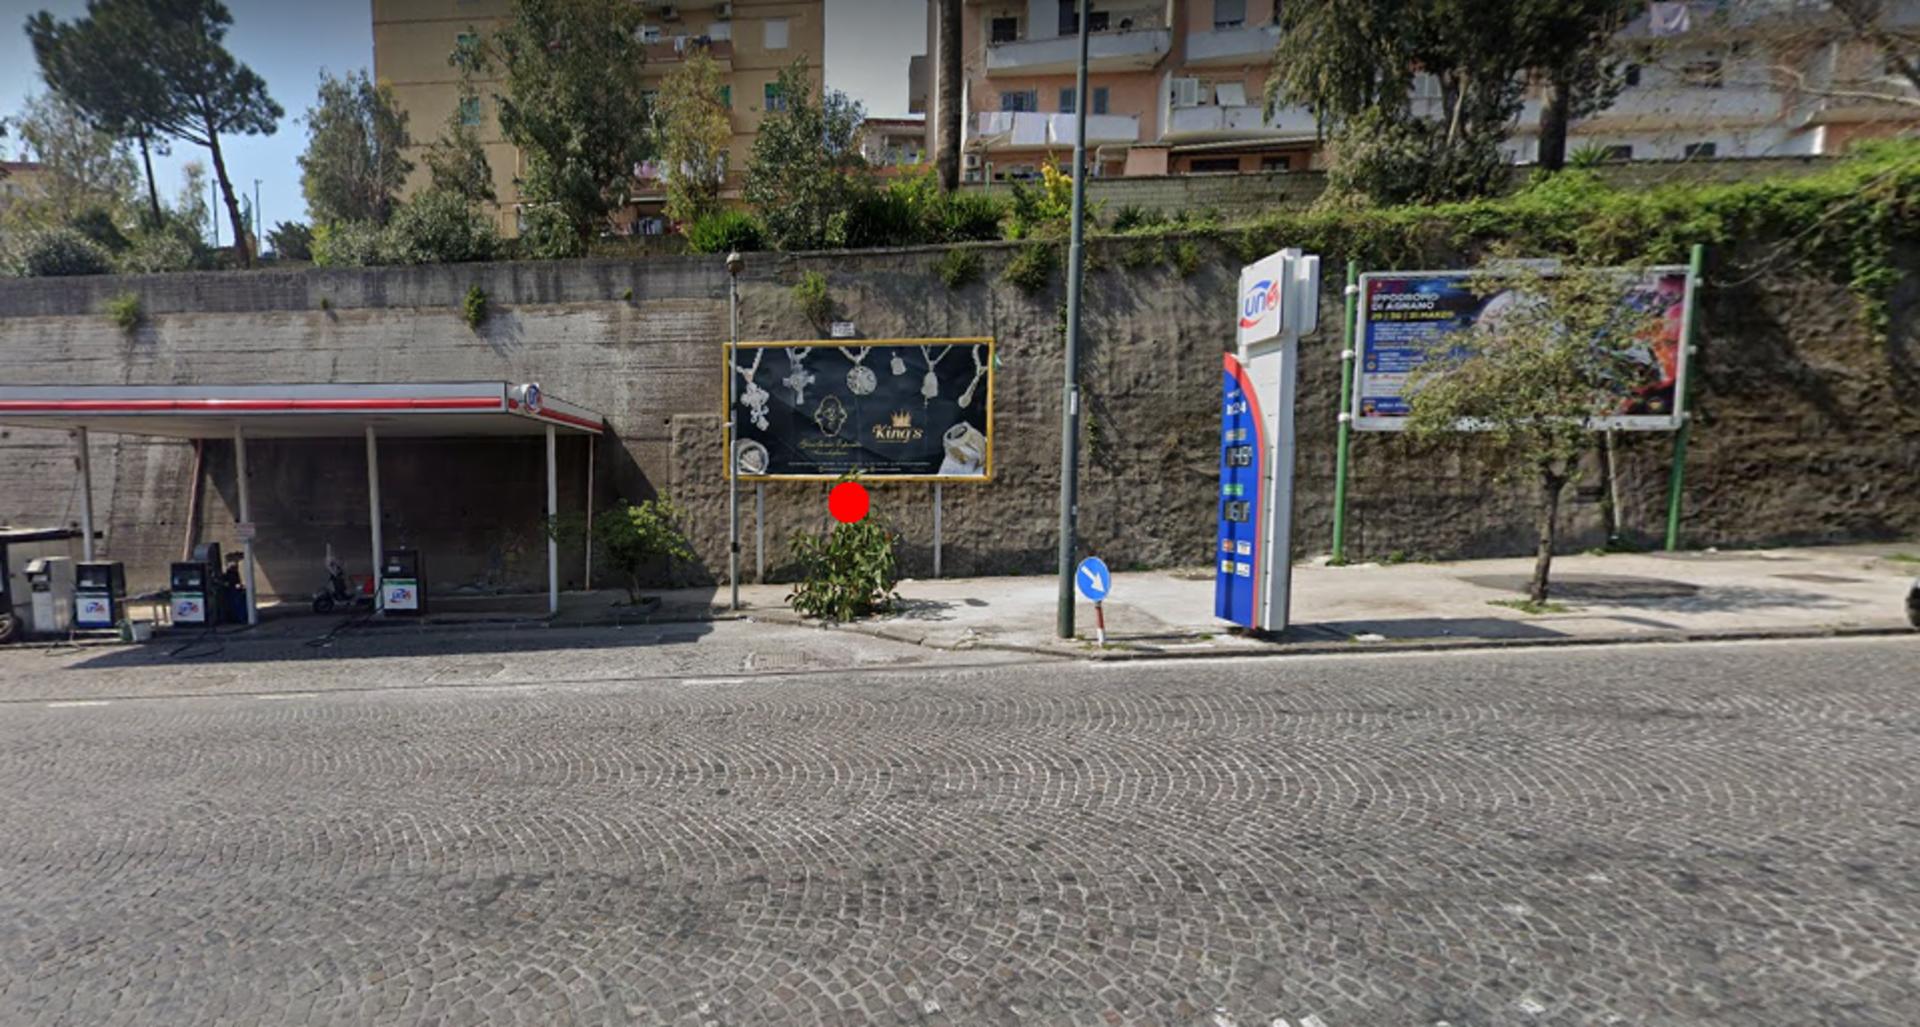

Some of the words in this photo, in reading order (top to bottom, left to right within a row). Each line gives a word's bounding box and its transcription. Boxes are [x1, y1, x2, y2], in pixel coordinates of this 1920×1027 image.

[1371, 292, 1440, 302] IPPODROMO
[1385, 301, 1435, 311] AGNANO
[872, 423, 924, 443] King's
